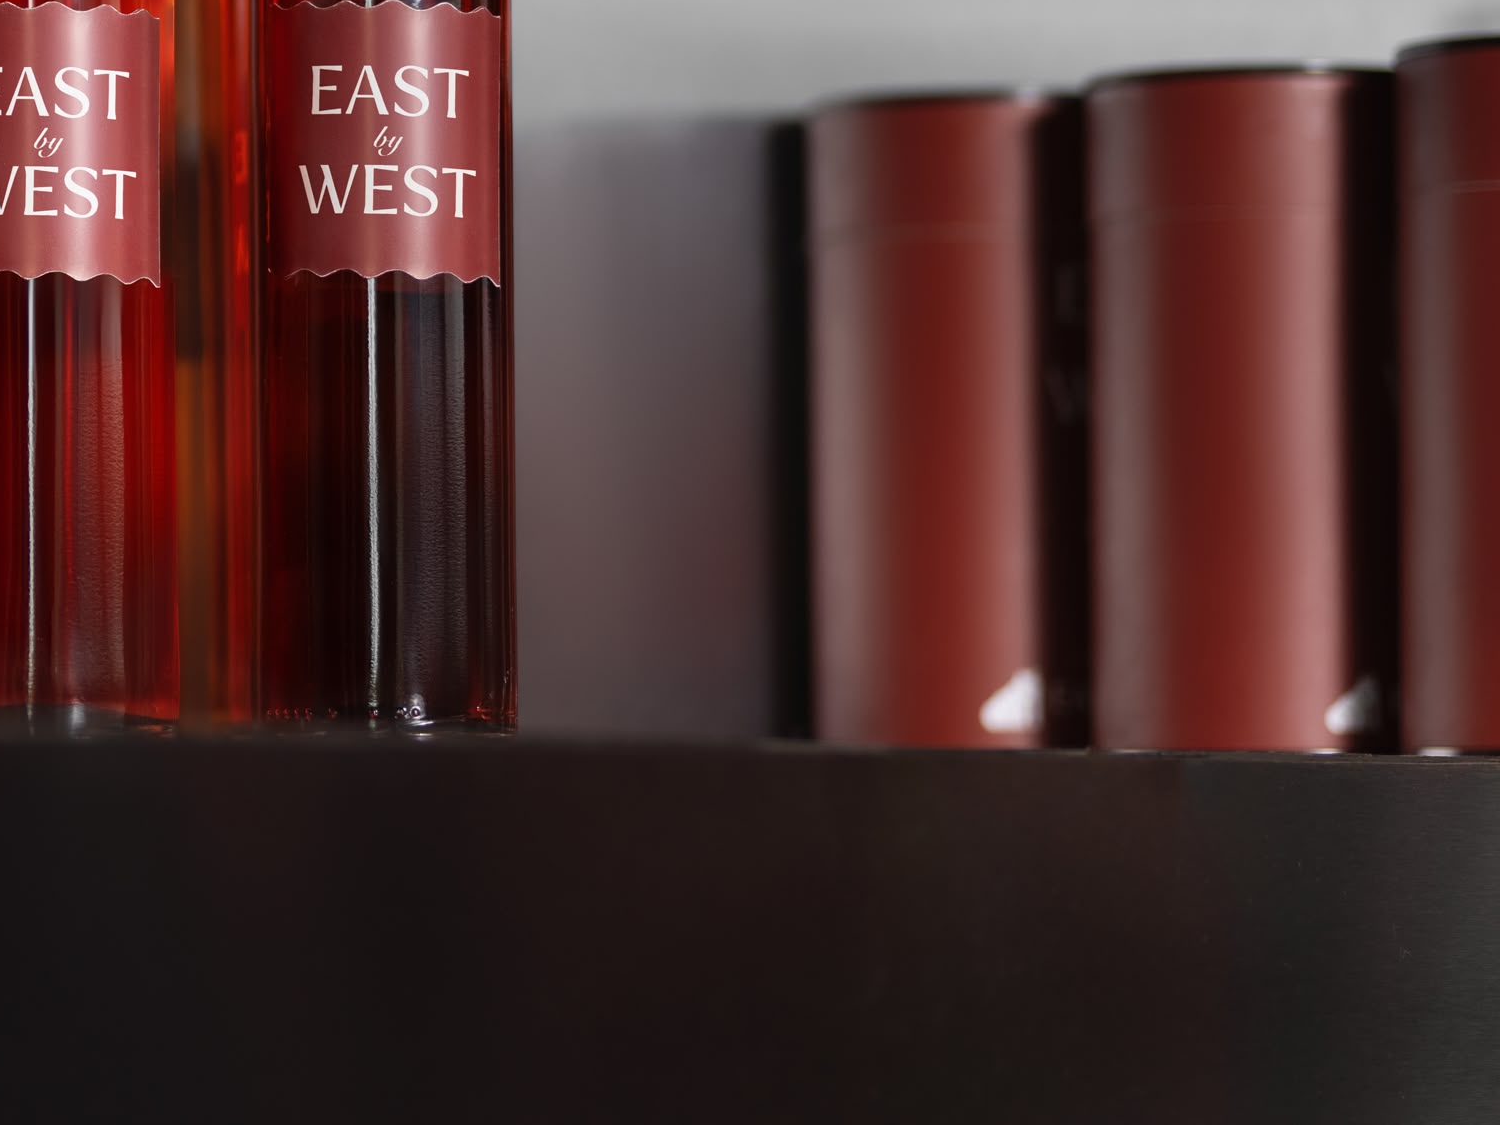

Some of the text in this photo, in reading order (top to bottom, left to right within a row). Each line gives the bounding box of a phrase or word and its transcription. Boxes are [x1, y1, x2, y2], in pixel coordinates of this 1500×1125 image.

[311, 64, 470, 119] EAST
[33, 127, 65, 159] by
[373, 125, 404, 157] by
[299, 164, 477, 219] WEST
